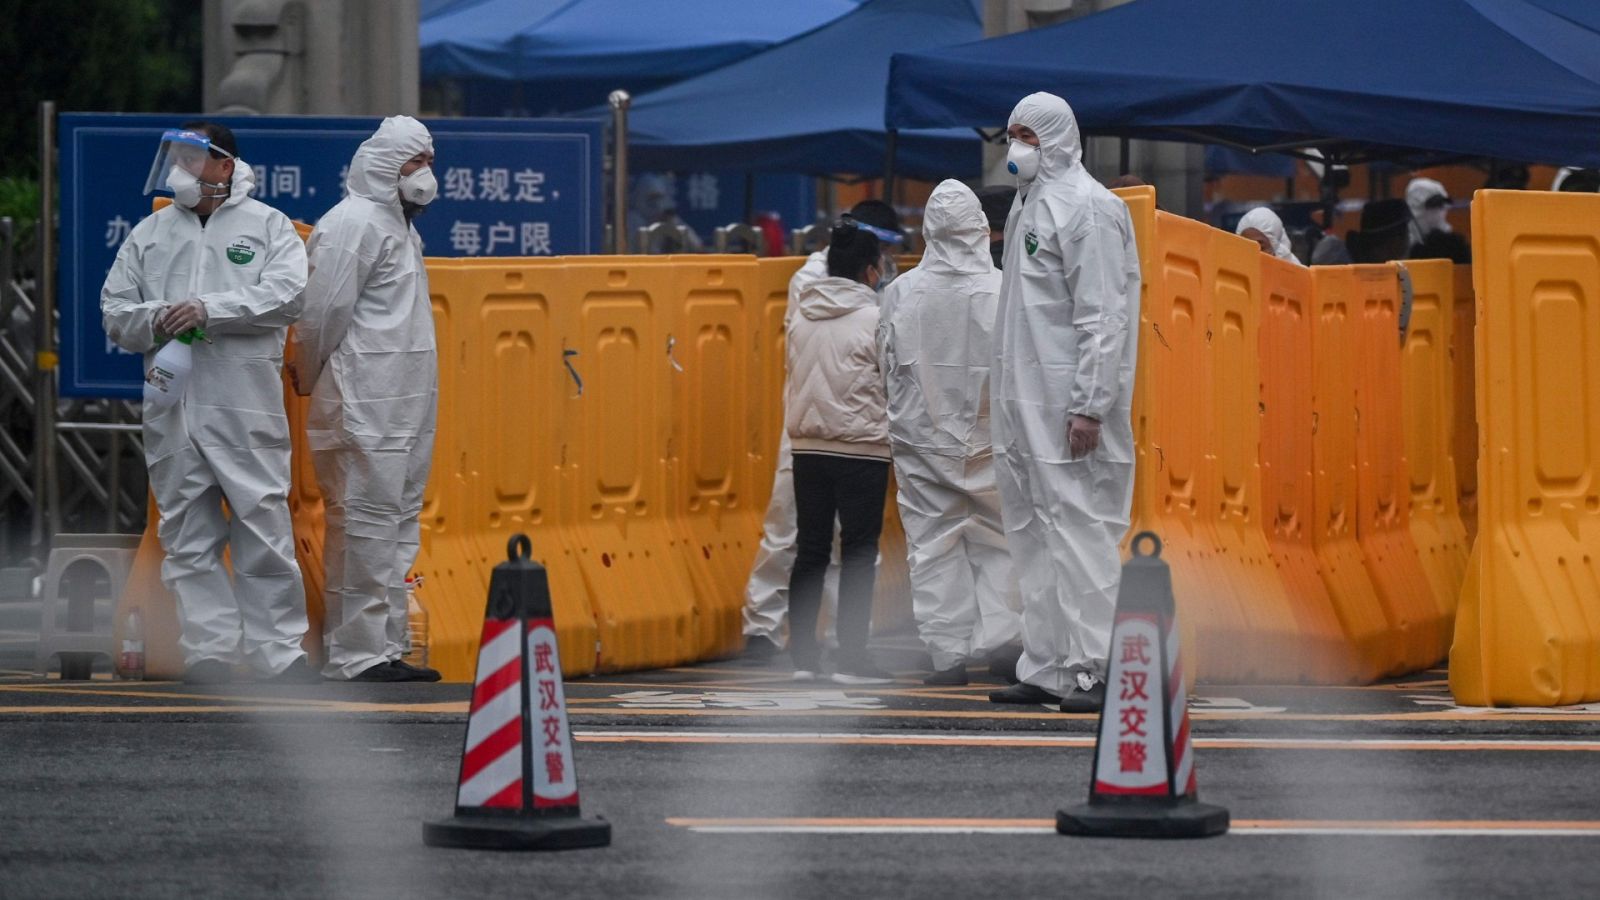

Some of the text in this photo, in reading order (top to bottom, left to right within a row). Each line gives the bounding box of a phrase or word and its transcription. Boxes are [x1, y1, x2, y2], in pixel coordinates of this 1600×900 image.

[450, 219, 552, 255] 每户限
[533, 642, 564, 784] 武汉交警
[1118, 633, 1151, 773] 武汉交警
